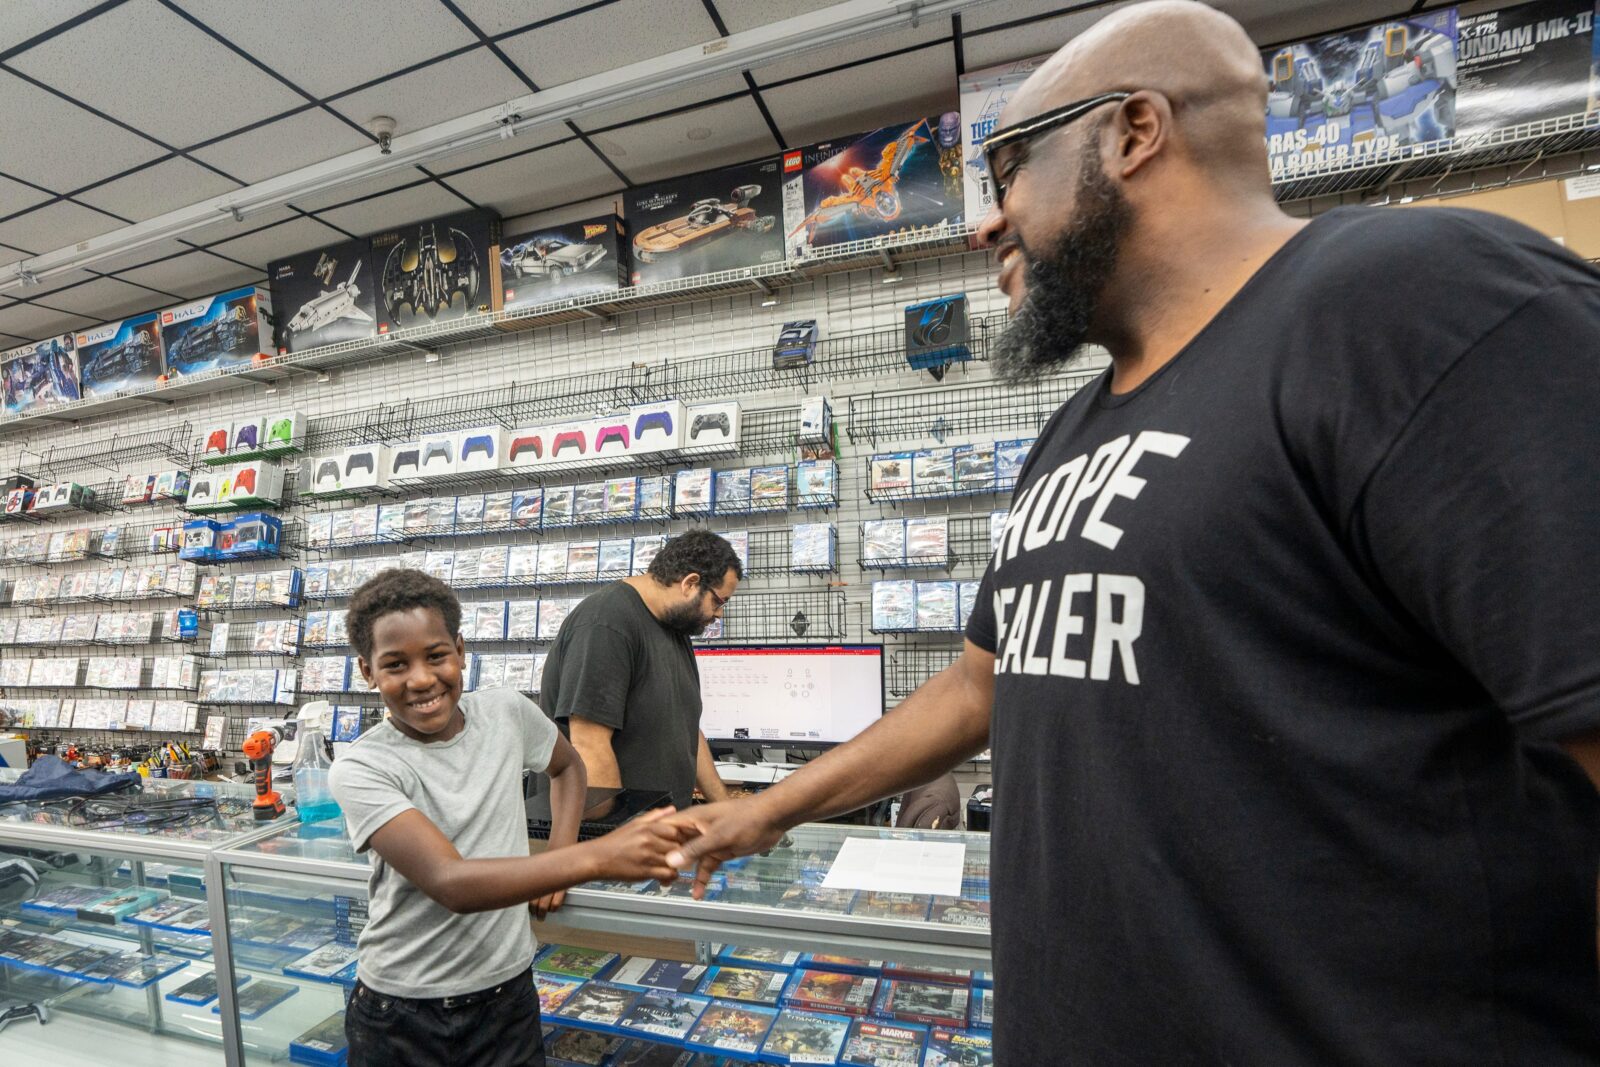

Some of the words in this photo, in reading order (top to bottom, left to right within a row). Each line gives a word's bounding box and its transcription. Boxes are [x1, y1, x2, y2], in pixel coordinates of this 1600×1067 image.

[785, 155, 801, 167] LEGO
[174, 305, 205, 319] HALO
[87, 328, 114, 342] HALO
[7, 346, 33, 359] HALO
[995, 430, 1192, 572] HOPE
[993, 573, 1145, 685] EALER
[881, 1027, 914, 1040] MARVEL
